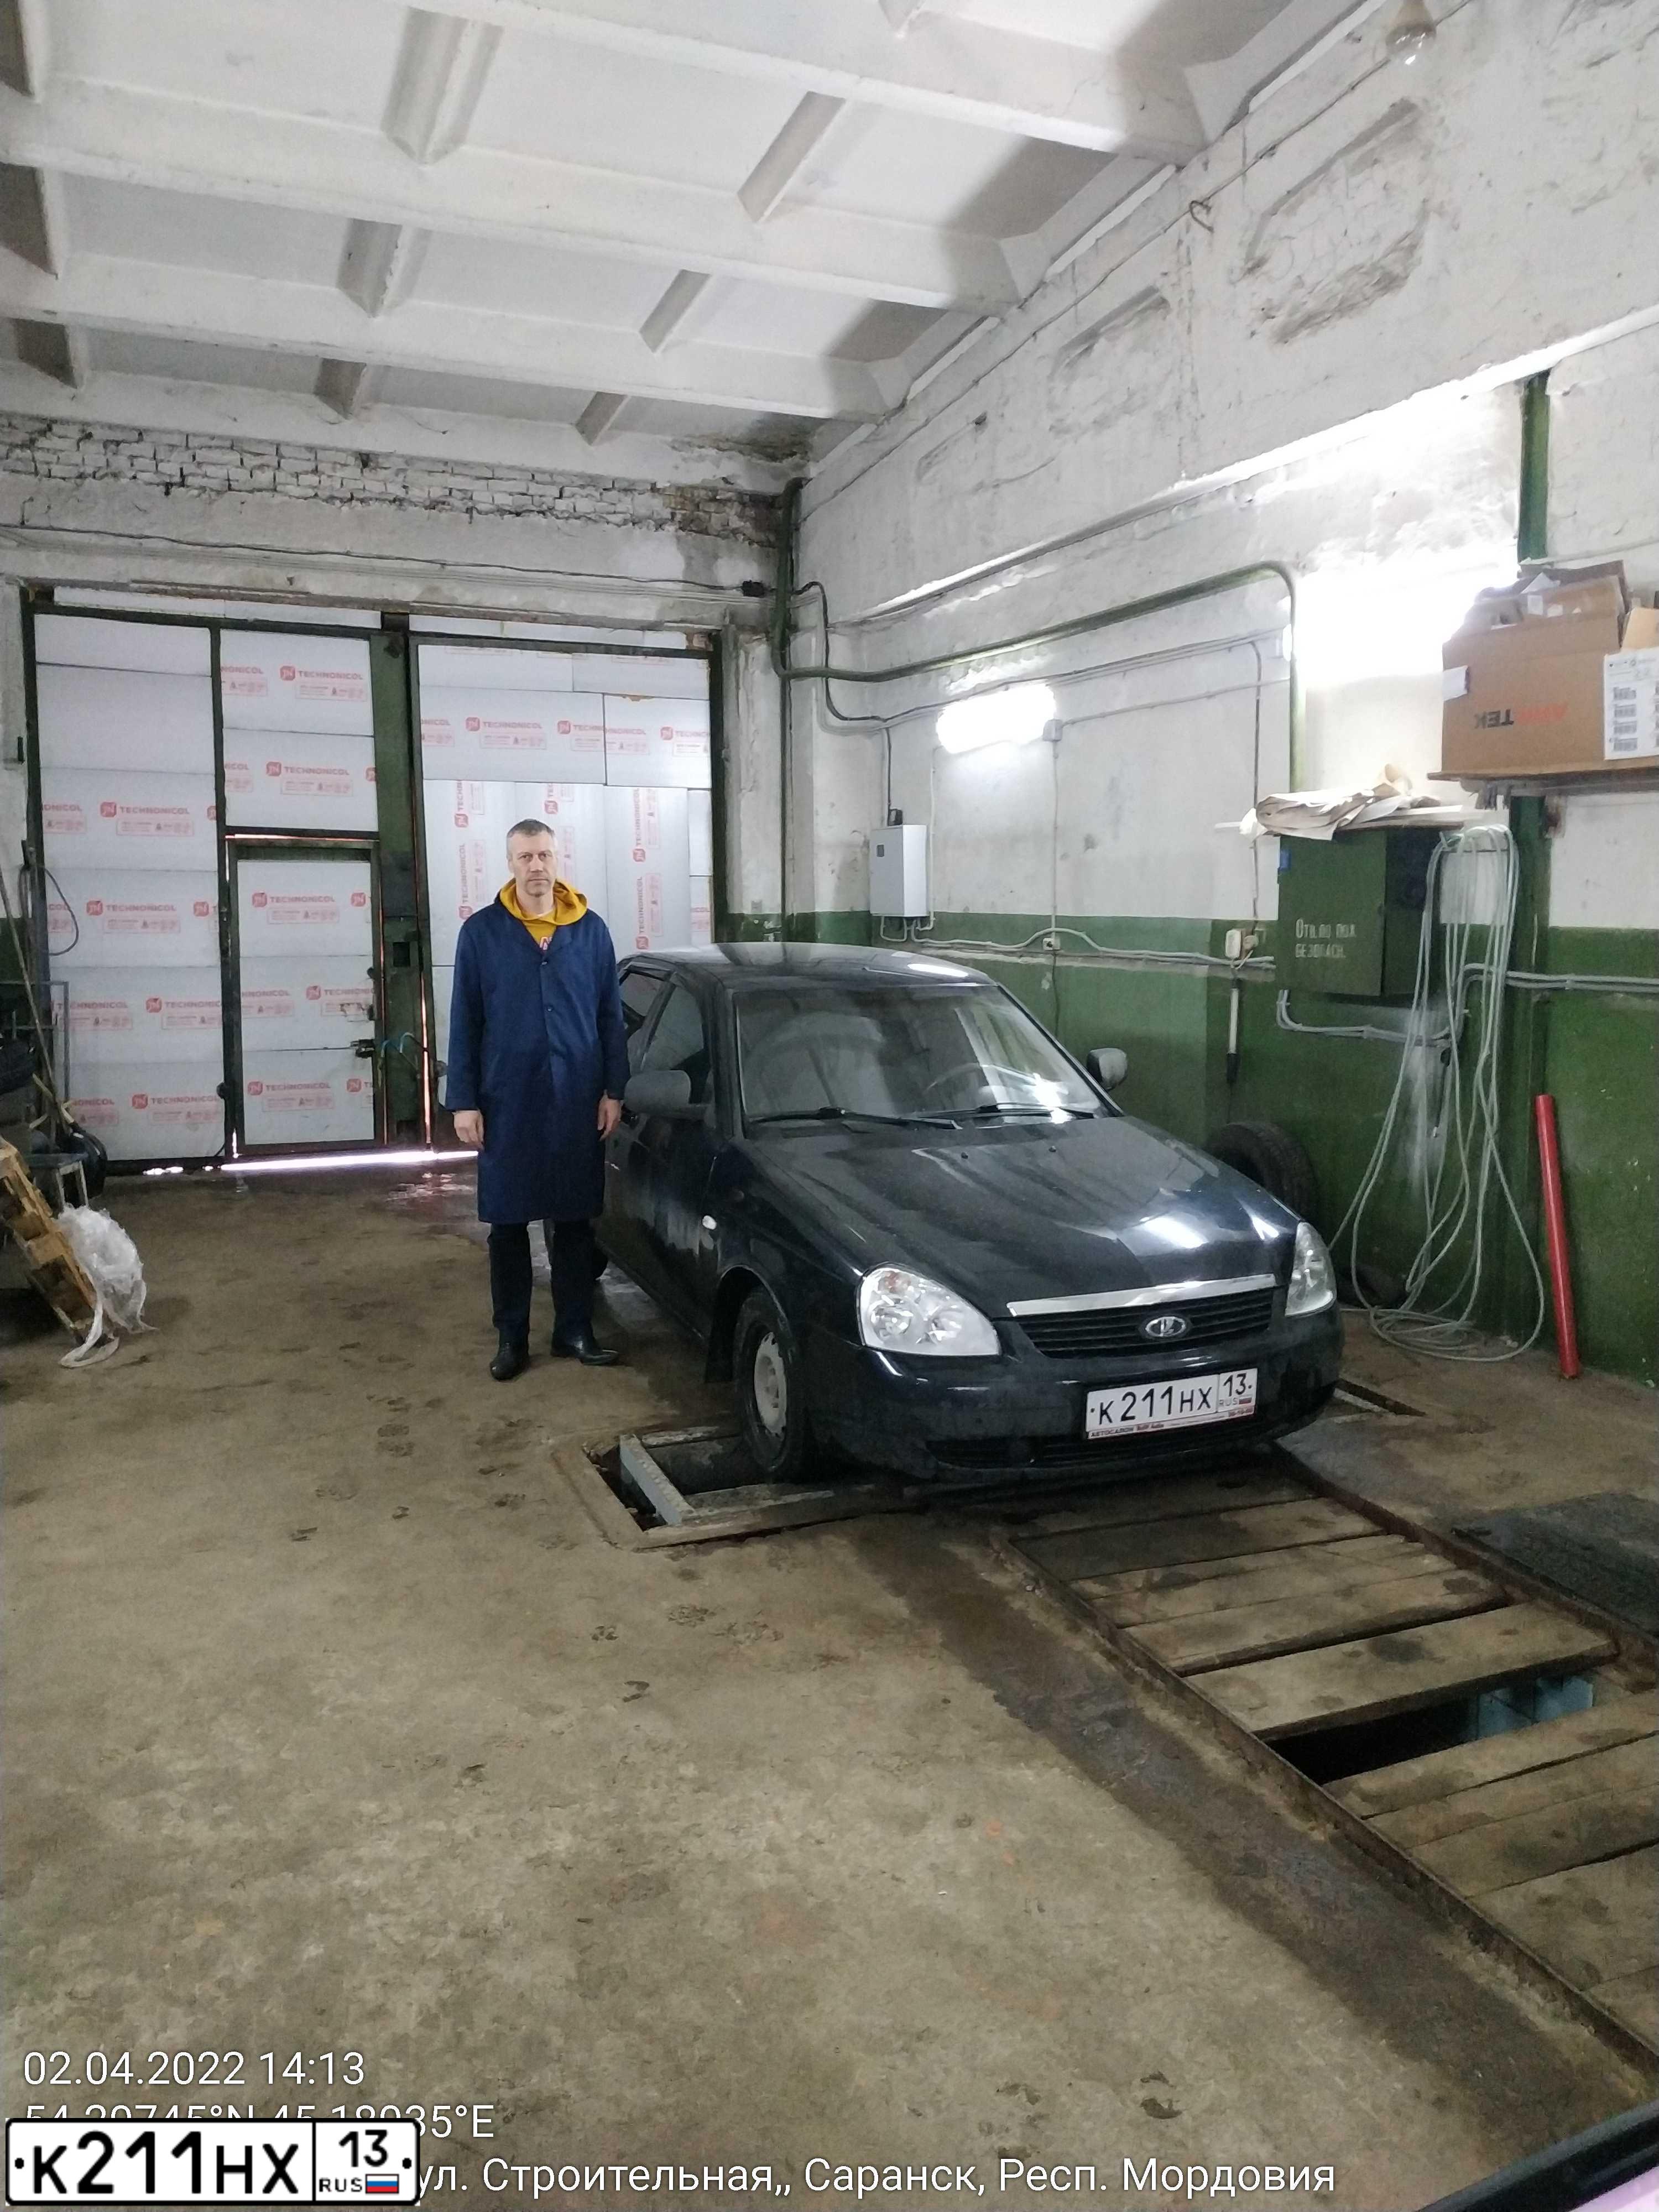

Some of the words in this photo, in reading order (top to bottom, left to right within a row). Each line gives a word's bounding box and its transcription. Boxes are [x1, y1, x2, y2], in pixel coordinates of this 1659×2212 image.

[1099, 1386, 1212, 1425] К211НХ
[1223, 1373, 1247, 1397] 13
[1219, 1397, 1238, 1406] RUS
